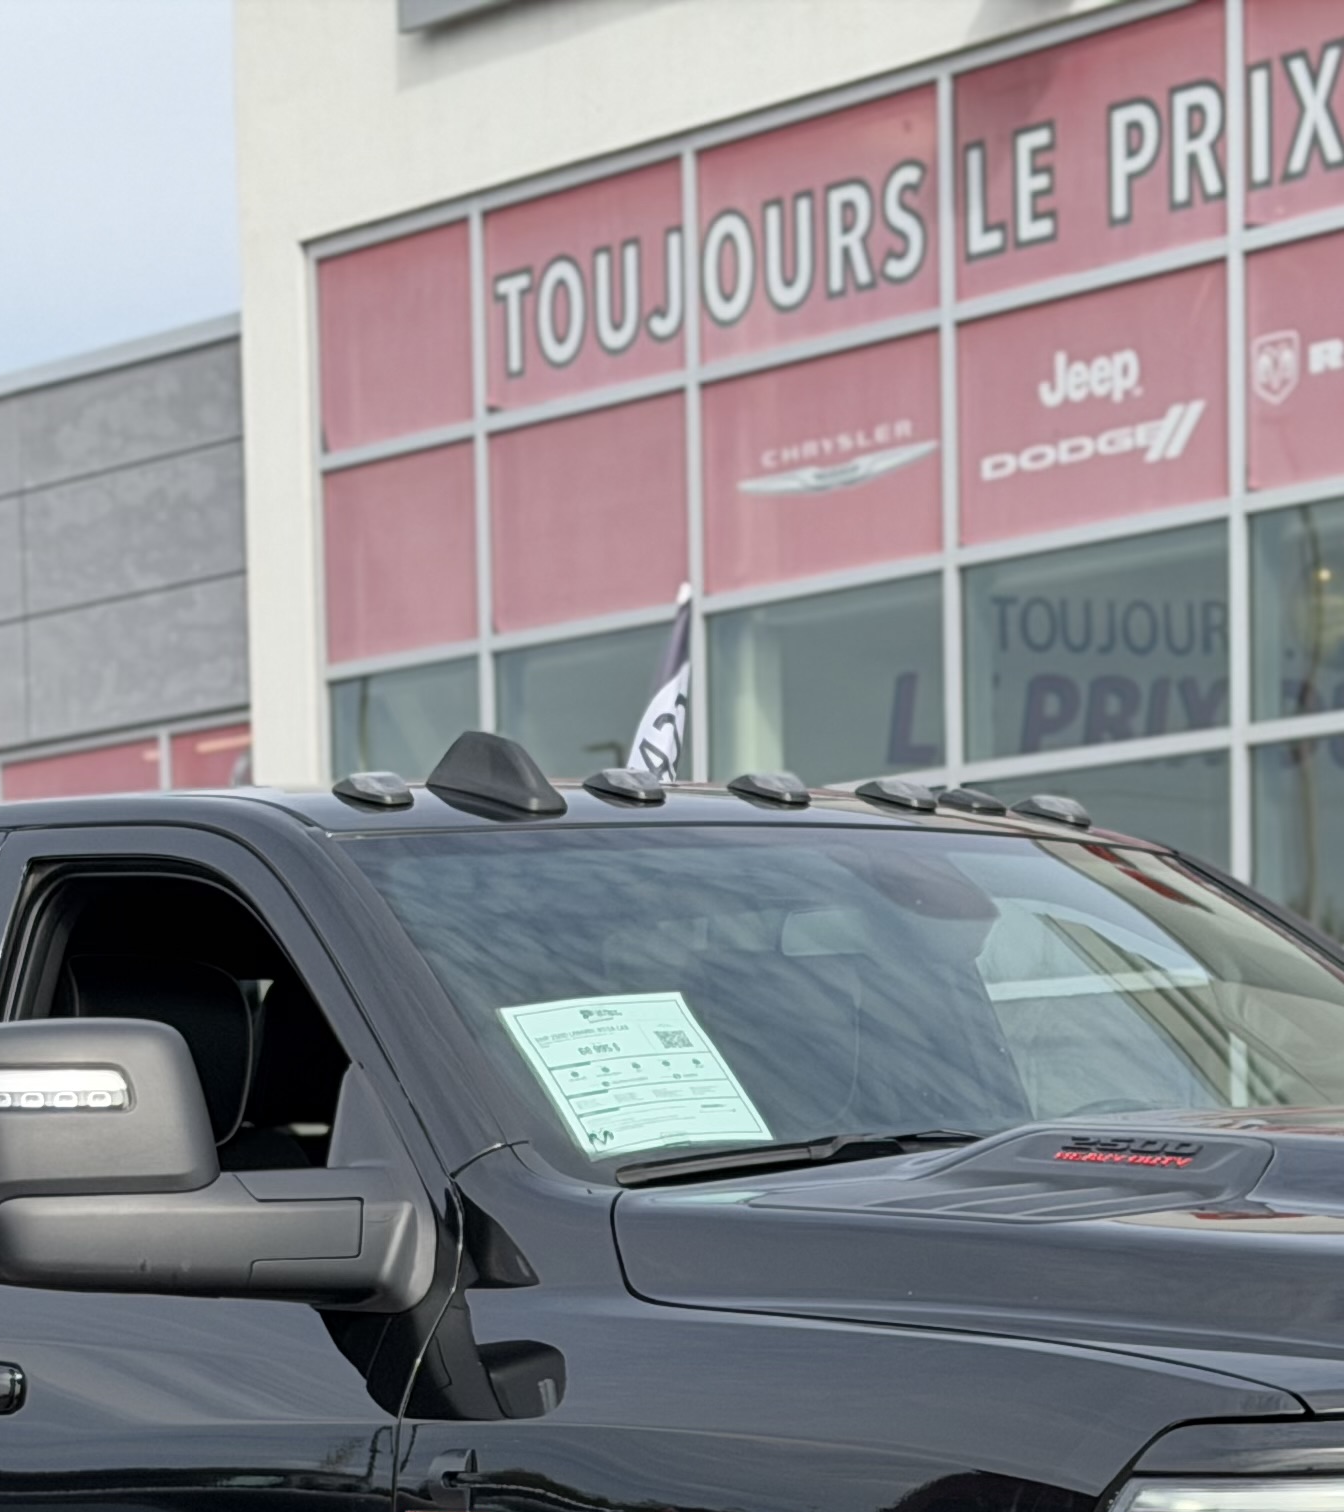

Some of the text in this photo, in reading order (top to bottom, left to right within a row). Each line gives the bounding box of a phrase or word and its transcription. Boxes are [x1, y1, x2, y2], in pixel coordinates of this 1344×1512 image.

[494, 160, 926, 379] TOUJOURS
[964, 121, 1057, 261] LE
[1039, 349, 1140, 408] Jeep
[759, 417, 914, 470] CHRYSLER
[979, 416, 1170, 482] DODGE
[1060, 1136, 1204, 1155] 2500
